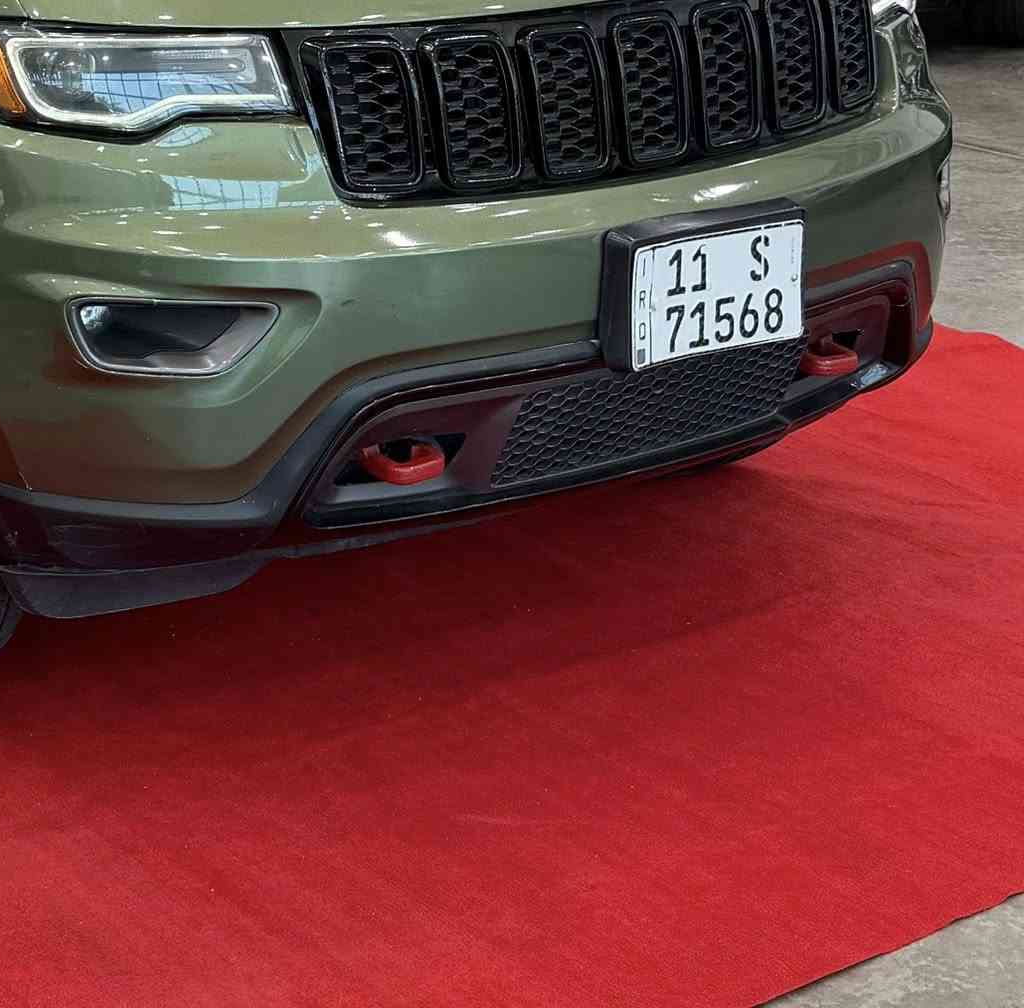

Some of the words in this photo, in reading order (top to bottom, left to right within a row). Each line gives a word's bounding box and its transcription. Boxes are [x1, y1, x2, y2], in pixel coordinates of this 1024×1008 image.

[666, 246, 707, 297] 11
[750, 234, 770, 282] S
[666, 287, 784, 353] 71568
